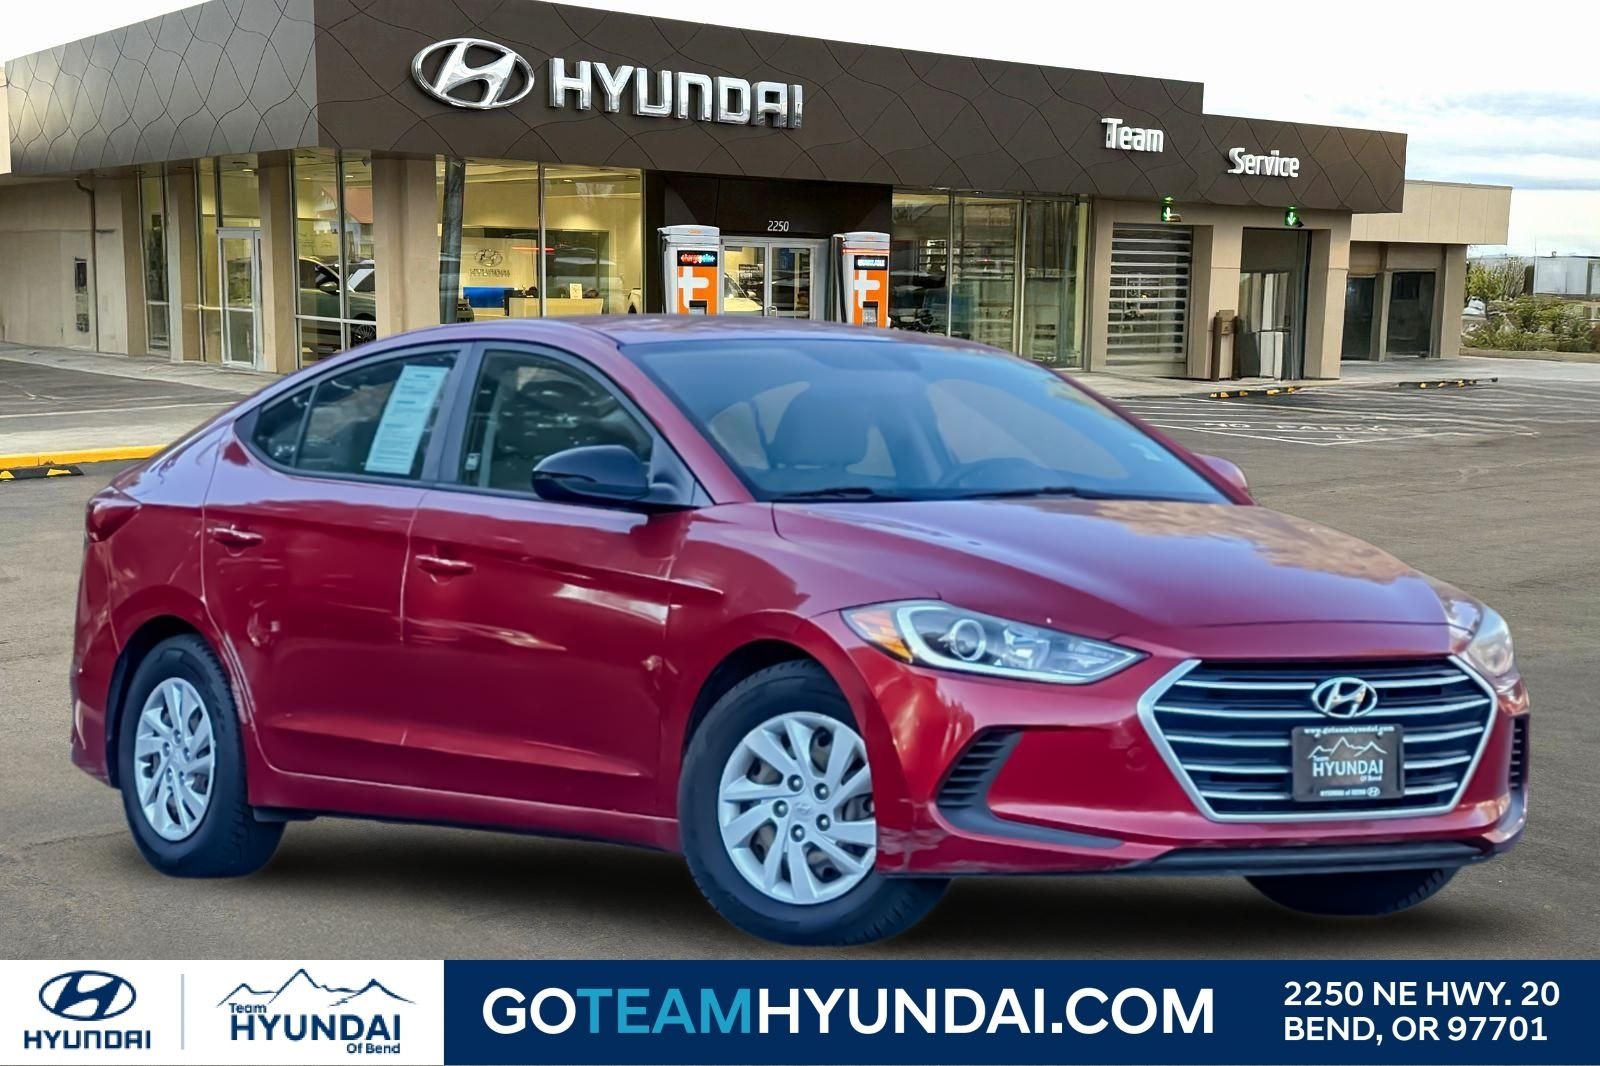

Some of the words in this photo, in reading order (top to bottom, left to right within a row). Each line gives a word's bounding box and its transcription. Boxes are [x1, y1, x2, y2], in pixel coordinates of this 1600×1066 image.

[549, 57, 803, 129] HYUNDAI
[1101, 117, 1164, 152] Team
[1227, 147, 1300, 178] Service
[767, 220, 790, 232] 2250
[1312, 760, 1383, 777] HYUNDAI
